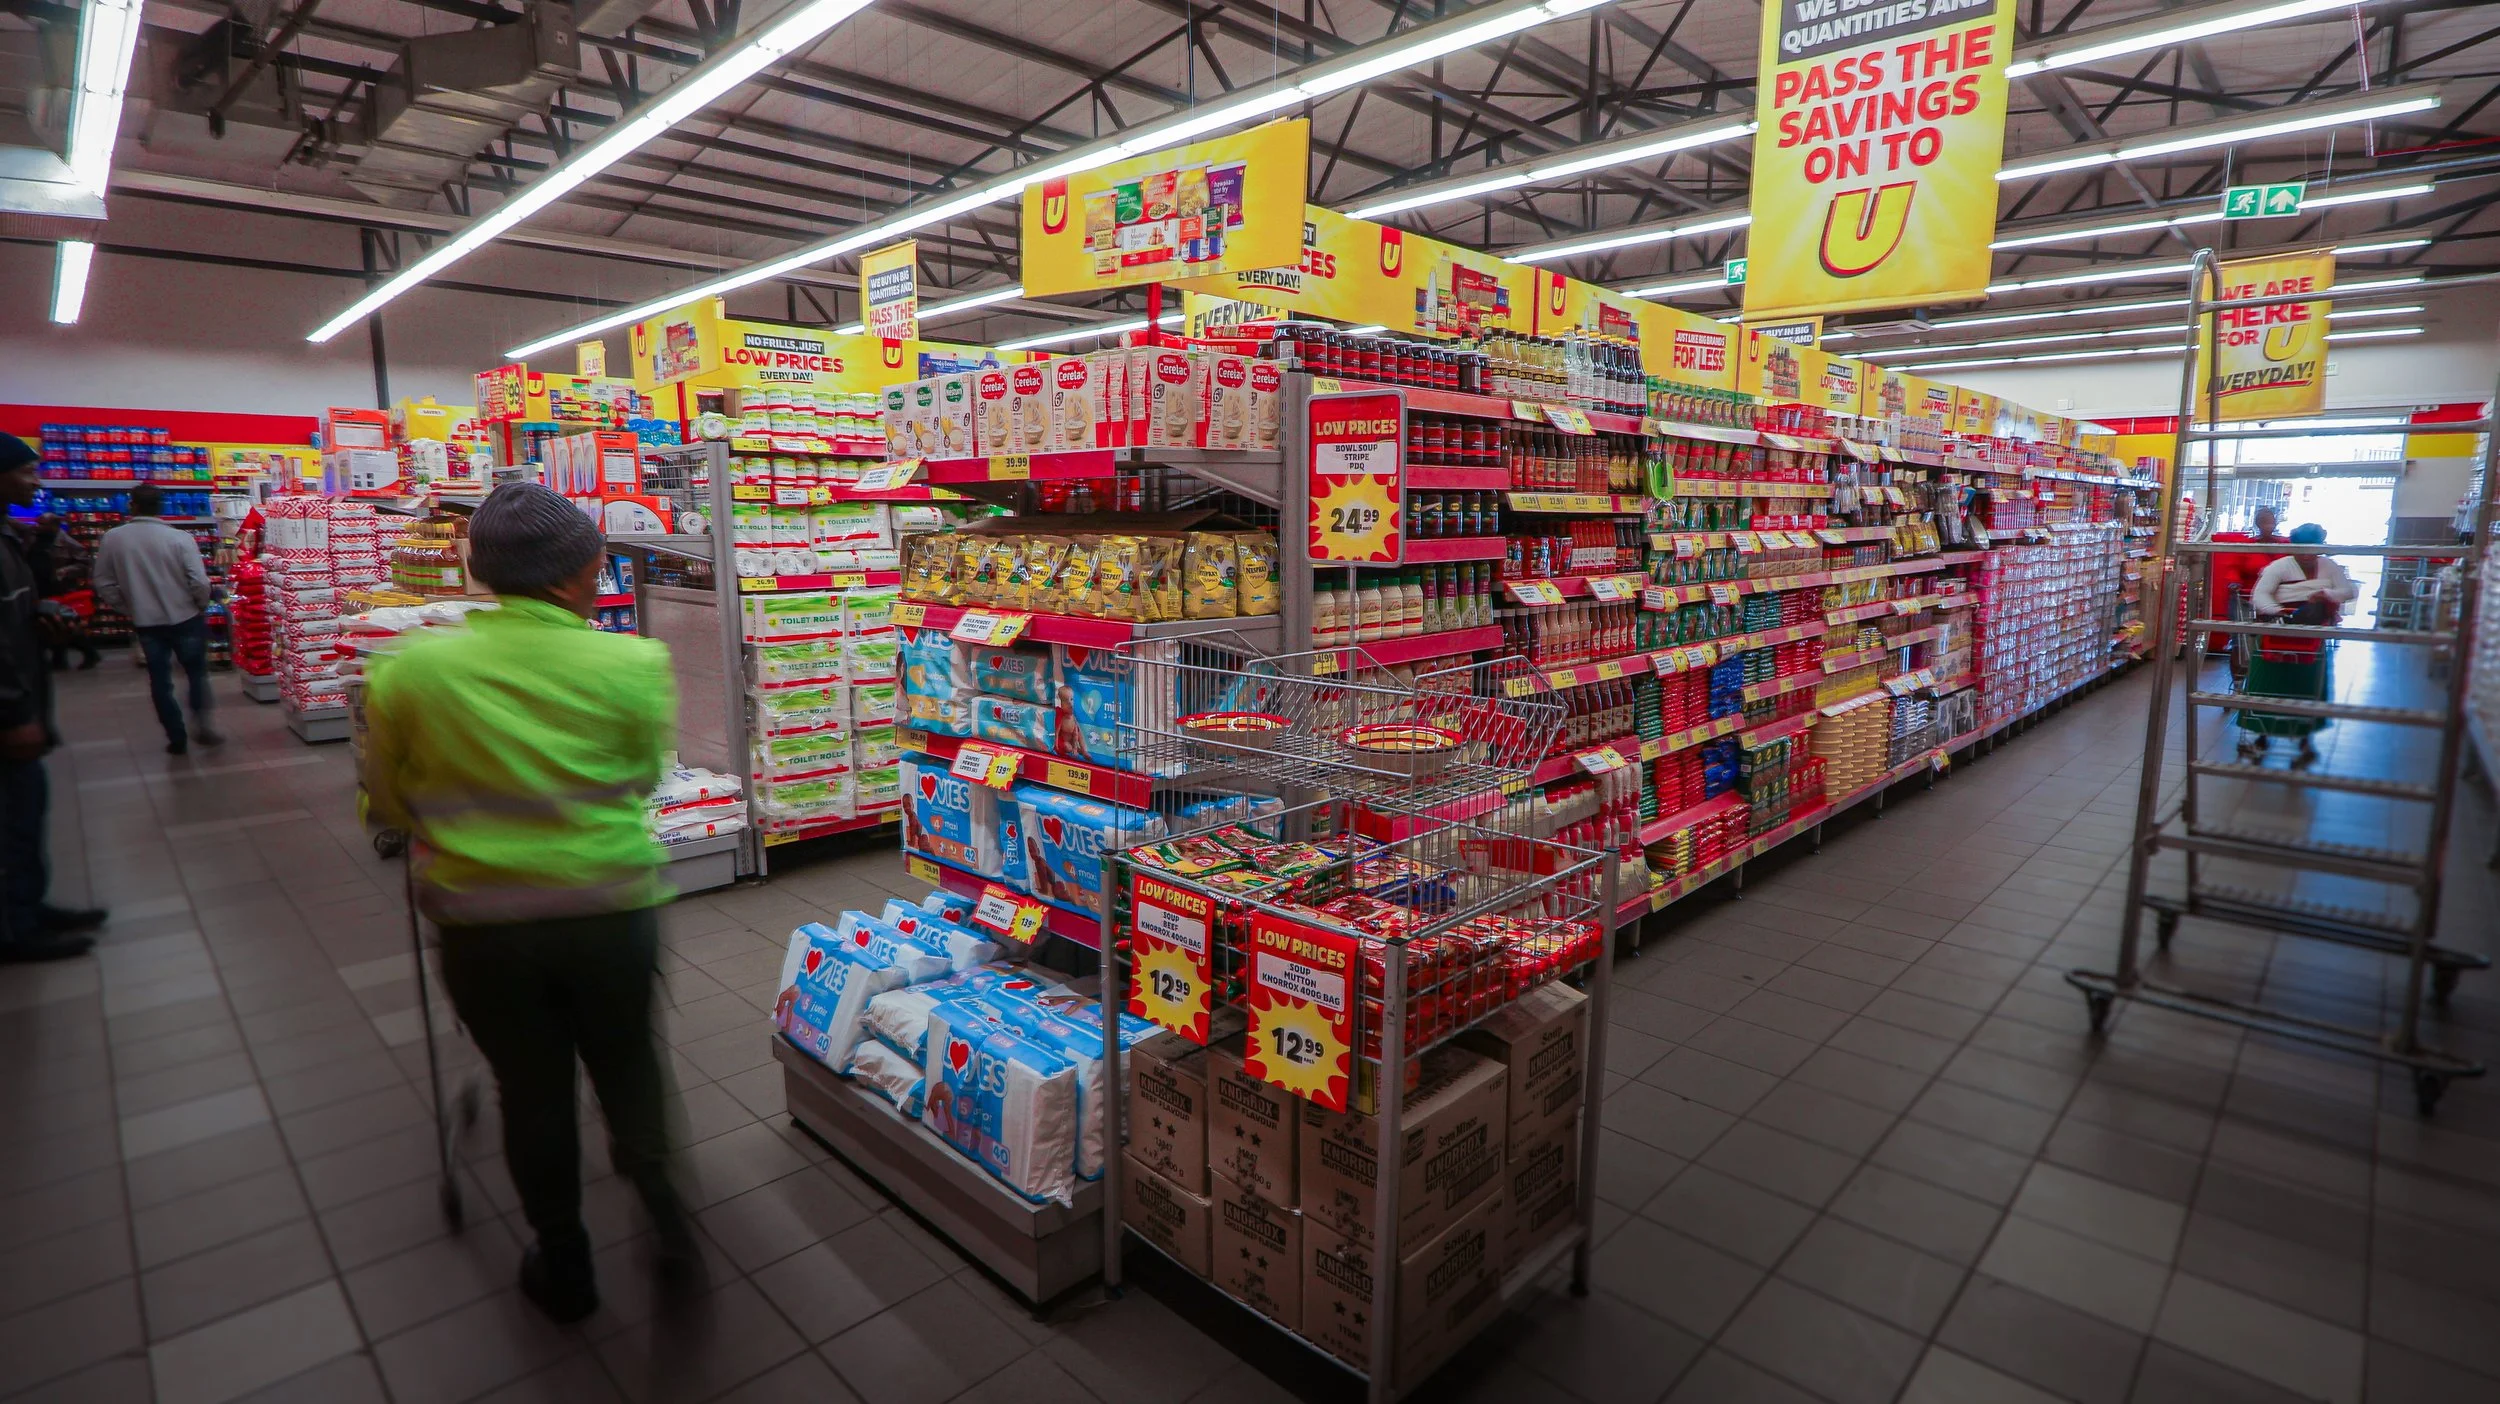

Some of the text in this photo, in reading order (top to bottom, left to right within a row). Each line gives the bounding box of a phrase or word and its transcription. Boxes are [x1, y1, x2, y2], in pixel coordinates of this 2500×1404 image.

[1782, 0, 1927, 54] QUANTITIES
[1773, 24, 1997, 109] PASS THE
[1777, 74, 1982, 149] SAVINGS
[1803, 126, 1944, 185] ON TO
[1820, 180, 1918, 279] U
[870, 270, 910, 288] WE BUY IN BIG
[1238, 270, 1300, 288] EVERY DAY!
[2263, 276, 2315, 298] ARE
[870, 282, 913, 303] QUANTITIES AND
[869, 301, 916, 327] PASS THE
[2218, 303, 2312, 329] HERE
[1676, 332, 1688, 342] JUST
[1784, 328, 1793, 336] IN
[1794, 326, 1810, 334] BIG
[1793, 334, 1814, 344] AND
[746, 335, 761, 346] NO
[799, 341, 823, 352] JUST
[2263, 323, 2310, 362] U
[724, 347, 844, 373] LOW PRICES
[1673, 346, 1726, 372] FOR LESS
[760, 371, 814, 381] EVERY DAY!
[1058, 369, 1084, 382] Cerelac
[1158, 363, 1187, 376] Cerelac
[1218, 367, 1244, 379] Cerelac
[1252, 372, 1278, 384] Cerelac
[981, 382, 1005, 393] Cerelac
[1015, 376, 1040, 388] Cerelac
[1316, 418, 1398, 436] LOW PRICES
[1335, 443, 1378, 452] BOWL SOUP
[1005, 457, 1028, 468] 39.99
[1344, 453, 1369, 461] STRIPE
[1349, 462, 1365, 471] PDQ
[1388, 476, 1397, 487] U
[828, 517, 872, 526] TOILET ROLLS
[780, 614, 840, 625] TOILET ROLLS
[812, 660, 839, 668] ROLLS
[788, 751, 846, 765] TOILET ROLLS
[1067, 769, 1089, 780] 139.99
[652, 795, 674, 803] SUPER
[659, 832, 681, 840] SUPER
[672, 836, 690, 844] MEAL
[1139, 879, 1208, 916] LOW PRICES
[1163, 911, 1180, 923] SOUP
[1163, 921, 1179, 931] BEEF
[1141, 921, 1202, 950] KNORROX 400G BAG
[1257, 927, 1346, 969] LOW PRICES
[1289, 963, 1311, 976] SOUP
[1284, 970, 1317, 989] MUTTON
[1262, 972, 1341, 1007] KNORROX 400G BAG
[1334, 1013, 1346, 1026] U
[817, 1034, 829, 1050] 40
[1529, 1033, 1572, 1077] KNORROX
[1139, 1073, 1190, 1113] KNORROX
[1220, 1078, 1275, 1120] KNORROX
[1158, 1100, 1191, 1123] FLAVOUR
[1241, 1107, 1279, 1131] FLAVOUR
[1321, 1138, 1378, 1178] KNORRO
[1426, 1130, 1484, 1182] KNORROX
[1225, 1203, 1283, 1243] KNORROX
